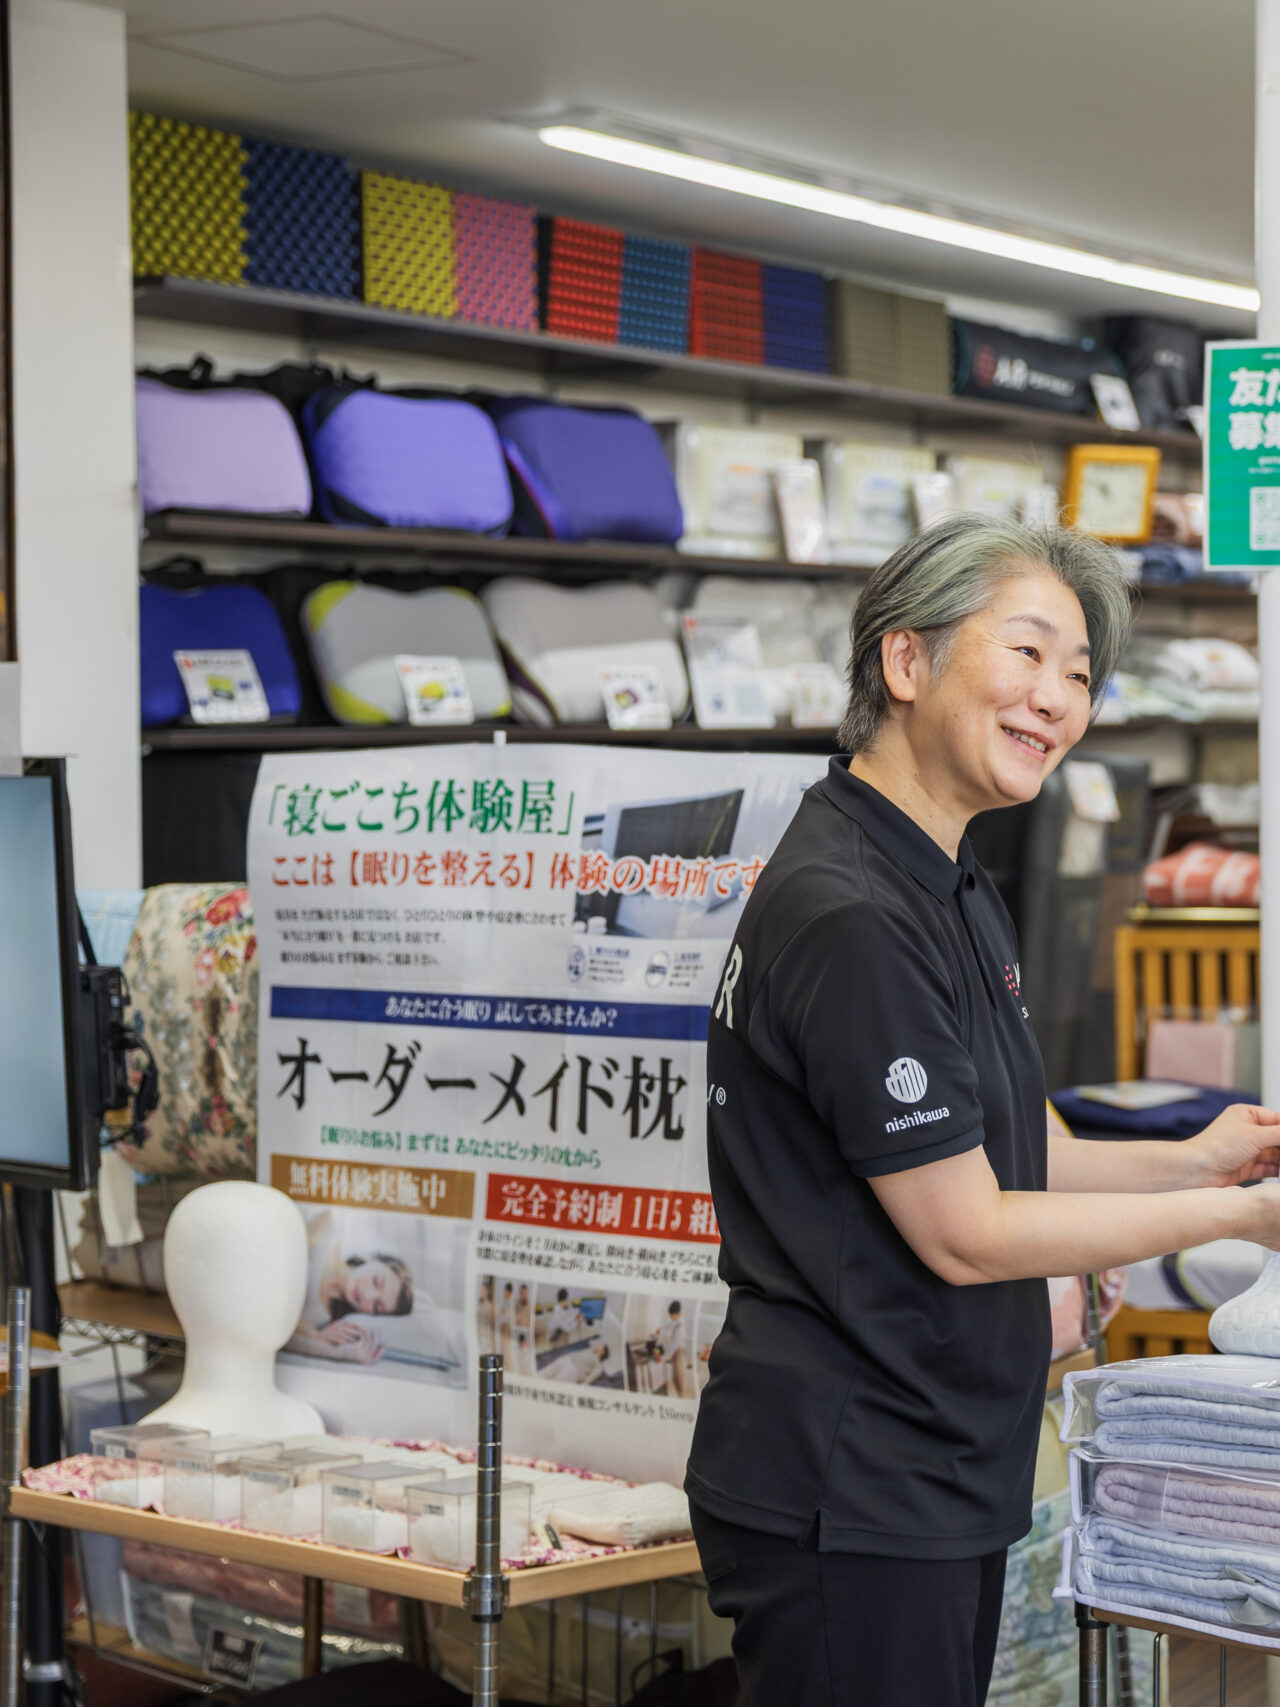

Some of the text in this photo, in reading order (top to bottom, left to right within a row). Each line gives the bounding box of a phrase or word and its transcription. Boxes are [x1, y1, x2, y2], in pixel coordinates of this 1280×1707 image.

[267, 779, 576, 837] 「寝ごこち体験屋」
[384, 997, 491, 1022] あなたに合う眠り
[276, 1037, 687, 1141] オーダーメイド枕
[885, 1105, 951, 1133] nishikawa
[289, 1160, 447, 1210] 無料体験実施中
[501, 1181, 623, 1228] 完全予約制
